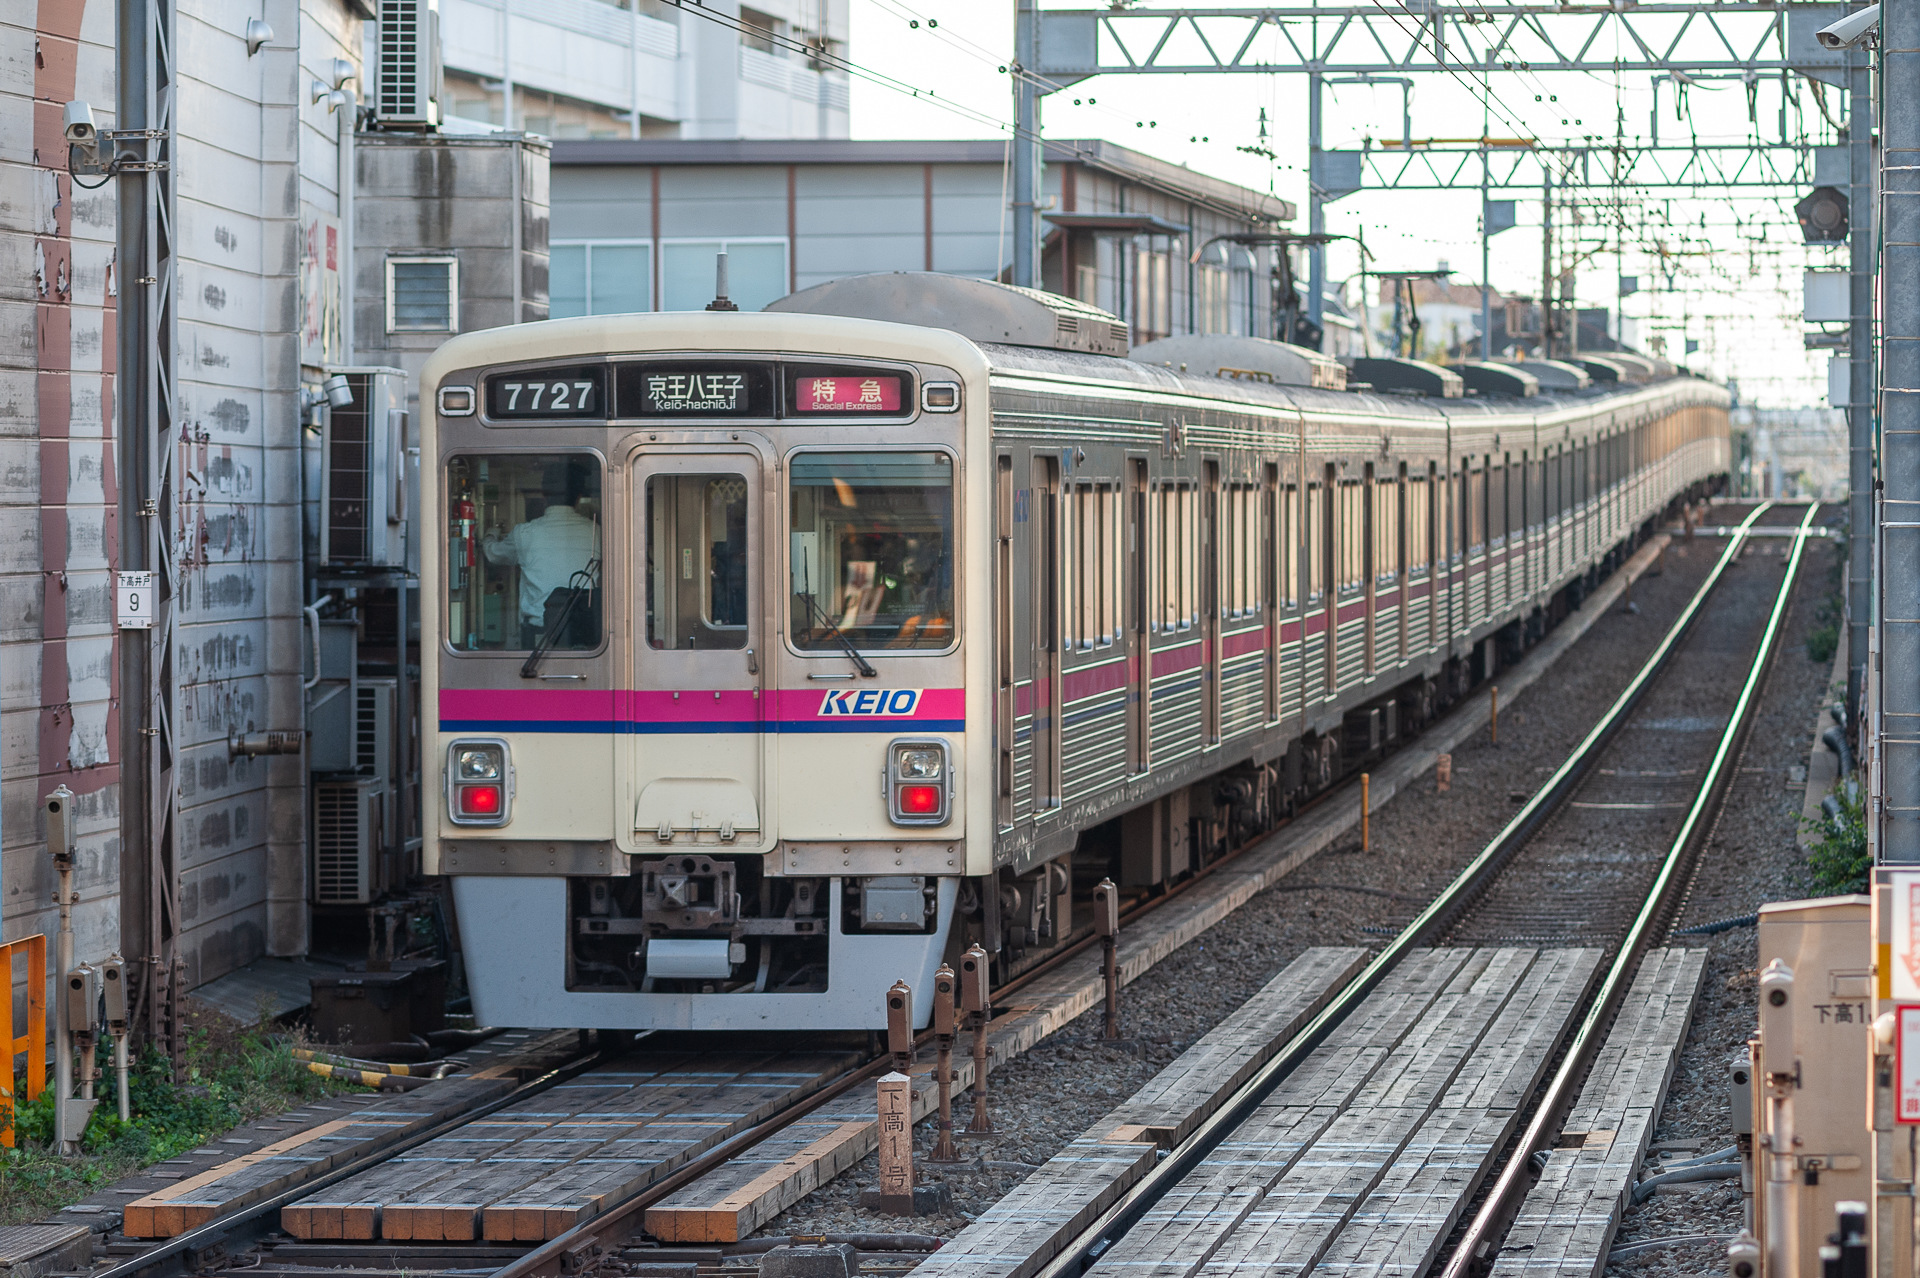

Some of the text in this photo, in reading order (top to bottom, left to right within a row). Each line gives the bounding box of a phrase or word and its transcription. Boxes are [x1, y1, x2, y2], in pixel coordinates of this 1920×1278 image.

[504, 382, 593, 410] 7727
[647, 374, 744, 400] 京王八王子
[812, 379, 883, 403] 特急
[812, 401, 883, 410] Special Express
[119, 576, 150, 586] 下高井戸
[130, 593, 139, 611] 9
[822, 690, 917, 715] KEIO
[1813, 1001, 1871, 1024] 下高1
[881, 1088, 907, 1188] 下高1号
